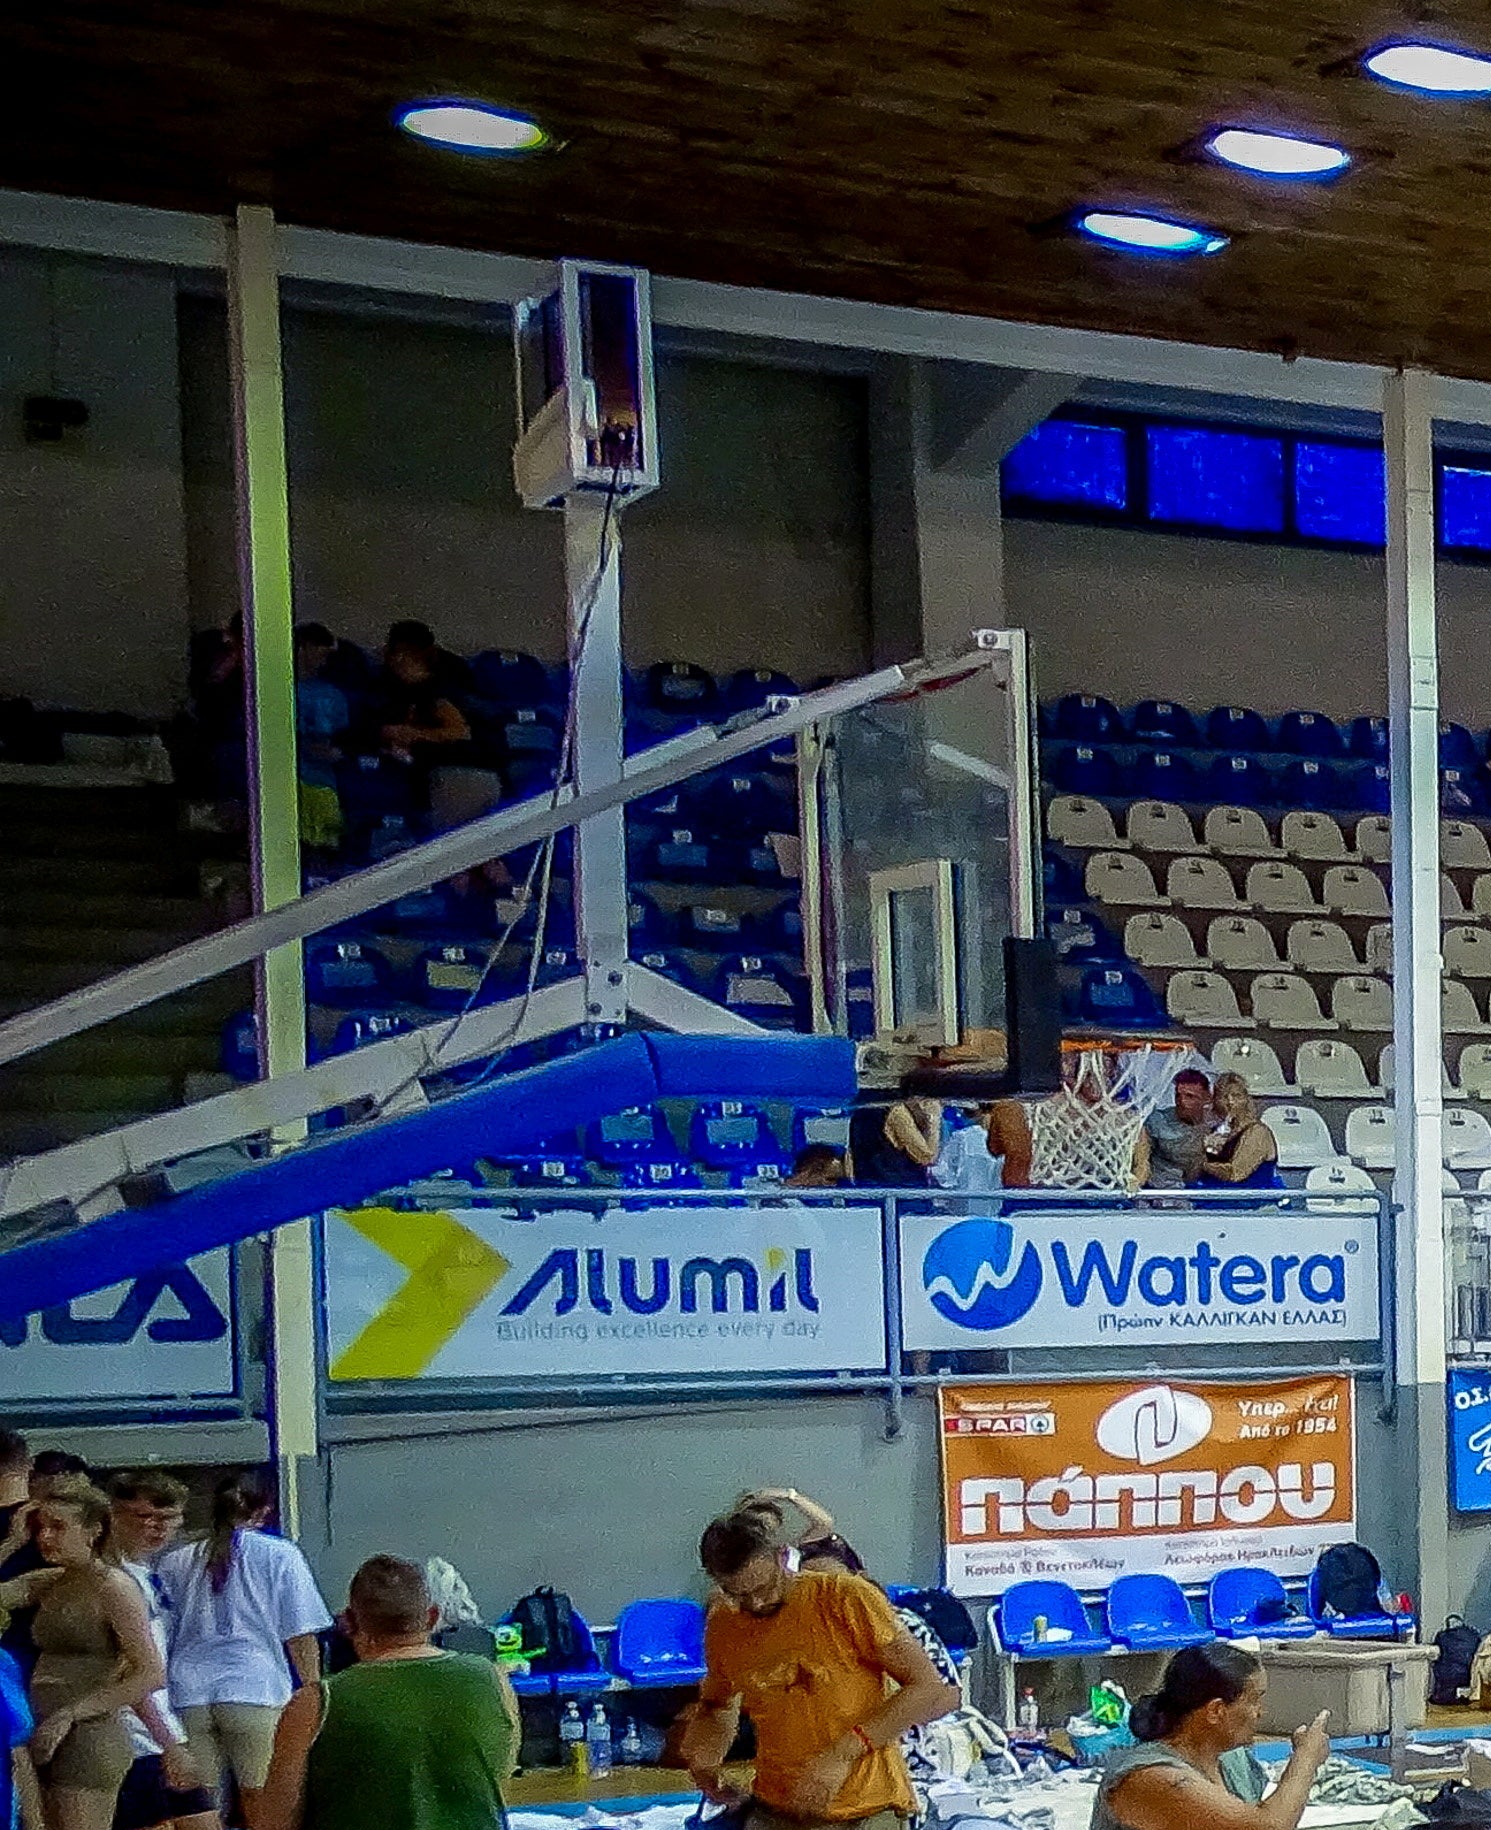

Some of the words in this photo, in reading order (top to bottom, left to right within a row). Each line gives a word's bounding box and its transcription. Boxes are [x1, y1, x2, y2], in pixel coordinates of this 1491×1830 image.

[499, 1247, 819, 1316] Alumil
[1051, 1239, 1346, 1307] Watera
[497, 1320, 588, 1343] Building
[596, 1318, 709, 1338] excellence
[717, 1321, 774, 1342] every
[782, 1320, 821, 1341] day
[956, 1416, 1026, 1433] SPAR
[1295, 1417, 1338, 1436] 1954
[960, 1463, 1336, 1536] πάππου
